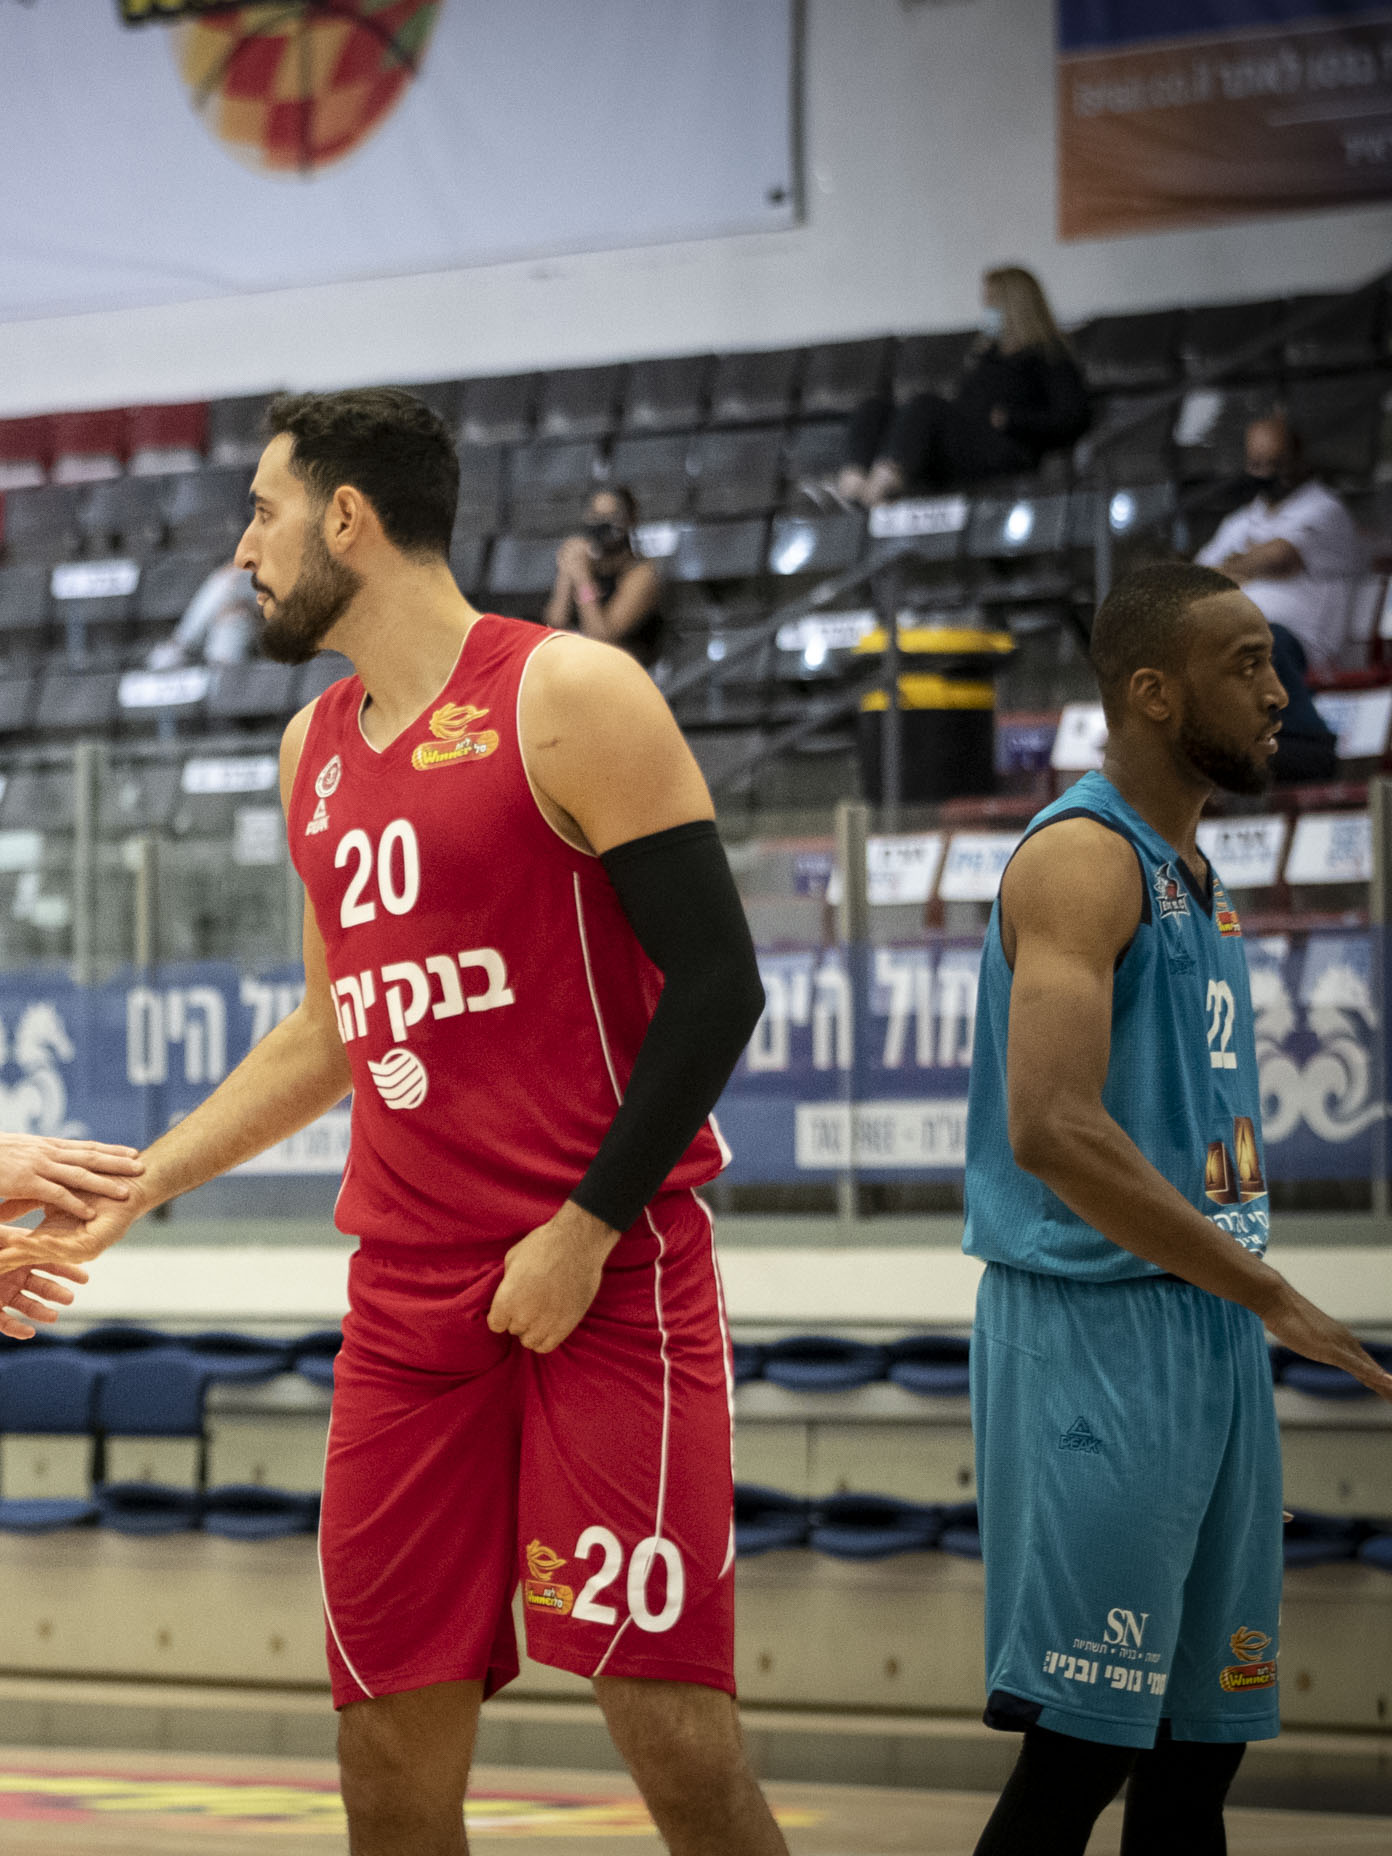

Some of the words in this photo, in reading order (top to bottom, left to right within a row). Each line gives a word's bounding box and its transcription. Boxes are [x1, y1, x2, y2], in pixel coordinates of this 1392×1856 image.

[334, 818, 420, 929] 20
[126, 984, 227, 1085] הים
[330, 969, 376, 1044] יה
[380, 947, 515, 1043] בנק
[1206, 979, 1238, 1069] 22
[1058, 1434, 1102, 1454] PEAK
[571, 1525, 685, 1633] 20
[1103, 1608, 1150, 1649] SN
[1228, 1672, 1270, 1687] Winner
